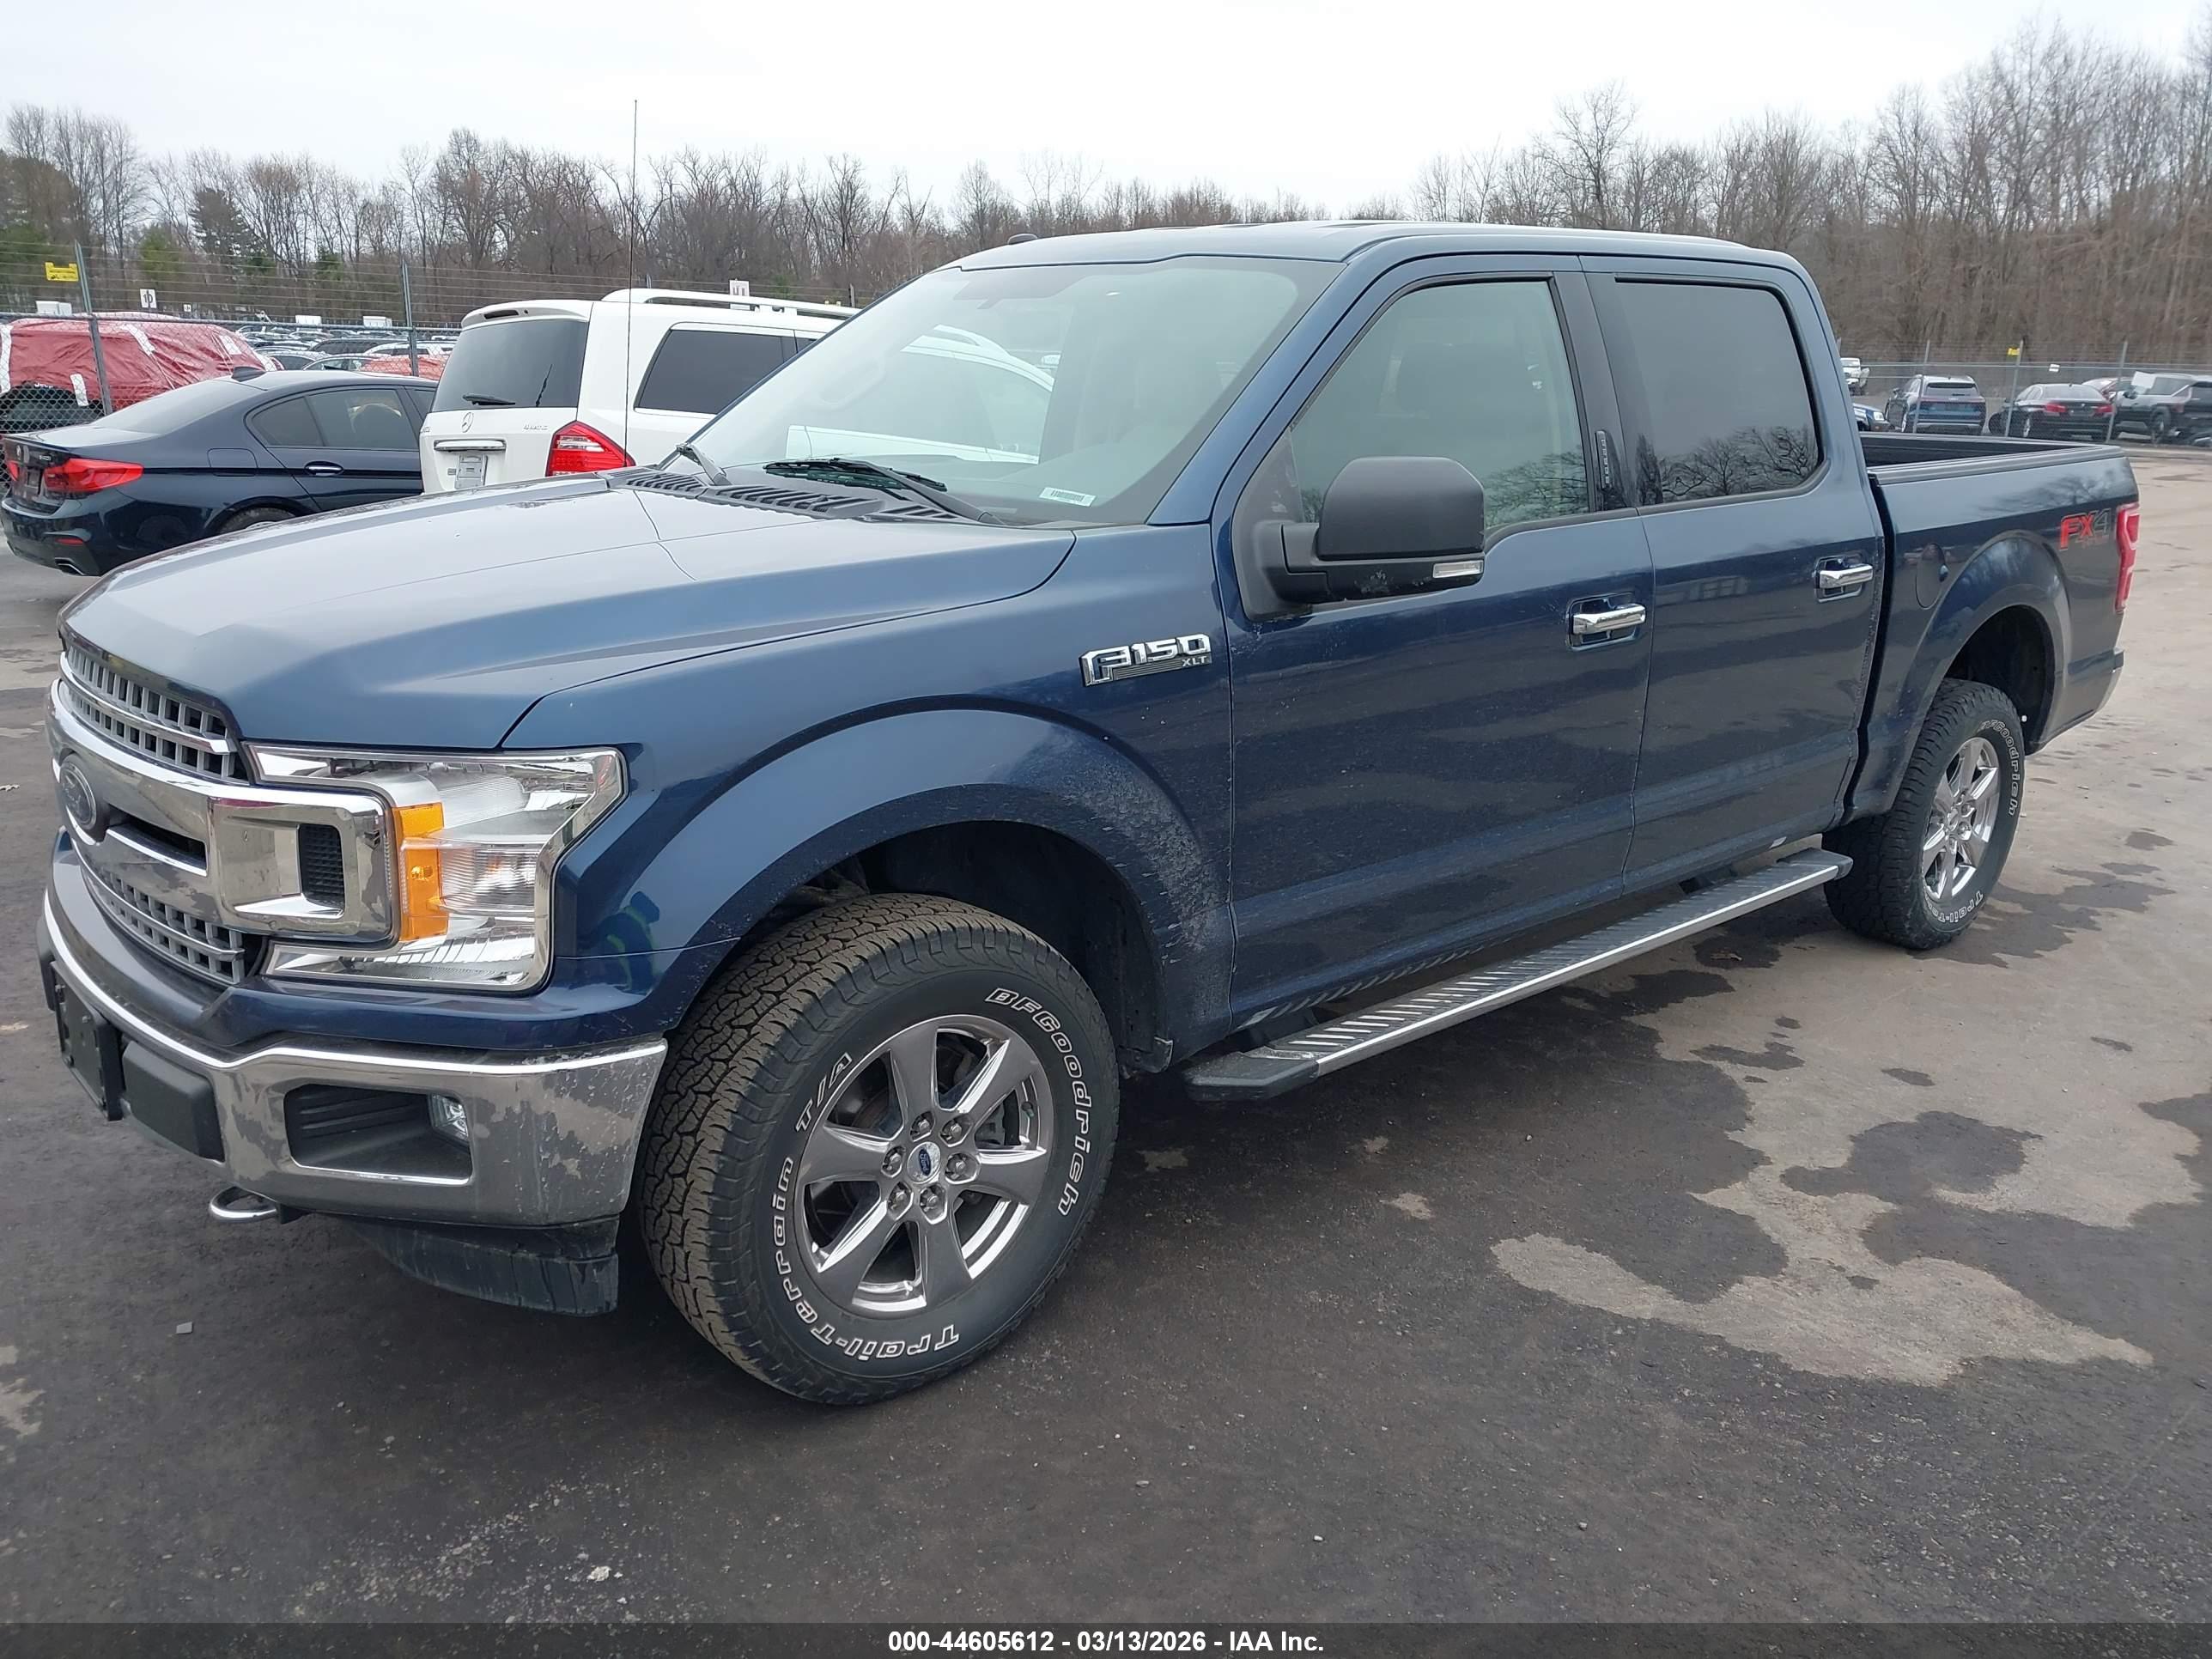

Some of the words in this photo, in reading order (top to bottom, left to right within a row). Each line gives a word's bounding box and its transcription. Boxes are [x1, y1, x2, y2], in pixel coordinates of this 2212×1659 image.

[2059, 507, 2112, 551] FX4
[1182, 655, 1207, 668] XLT
[795, 1051, 853, 1132] T/A
[985, 988, 1092, 1216] BFGoodrich
[772, 1157, 960, 1361] Trail-Terrain
